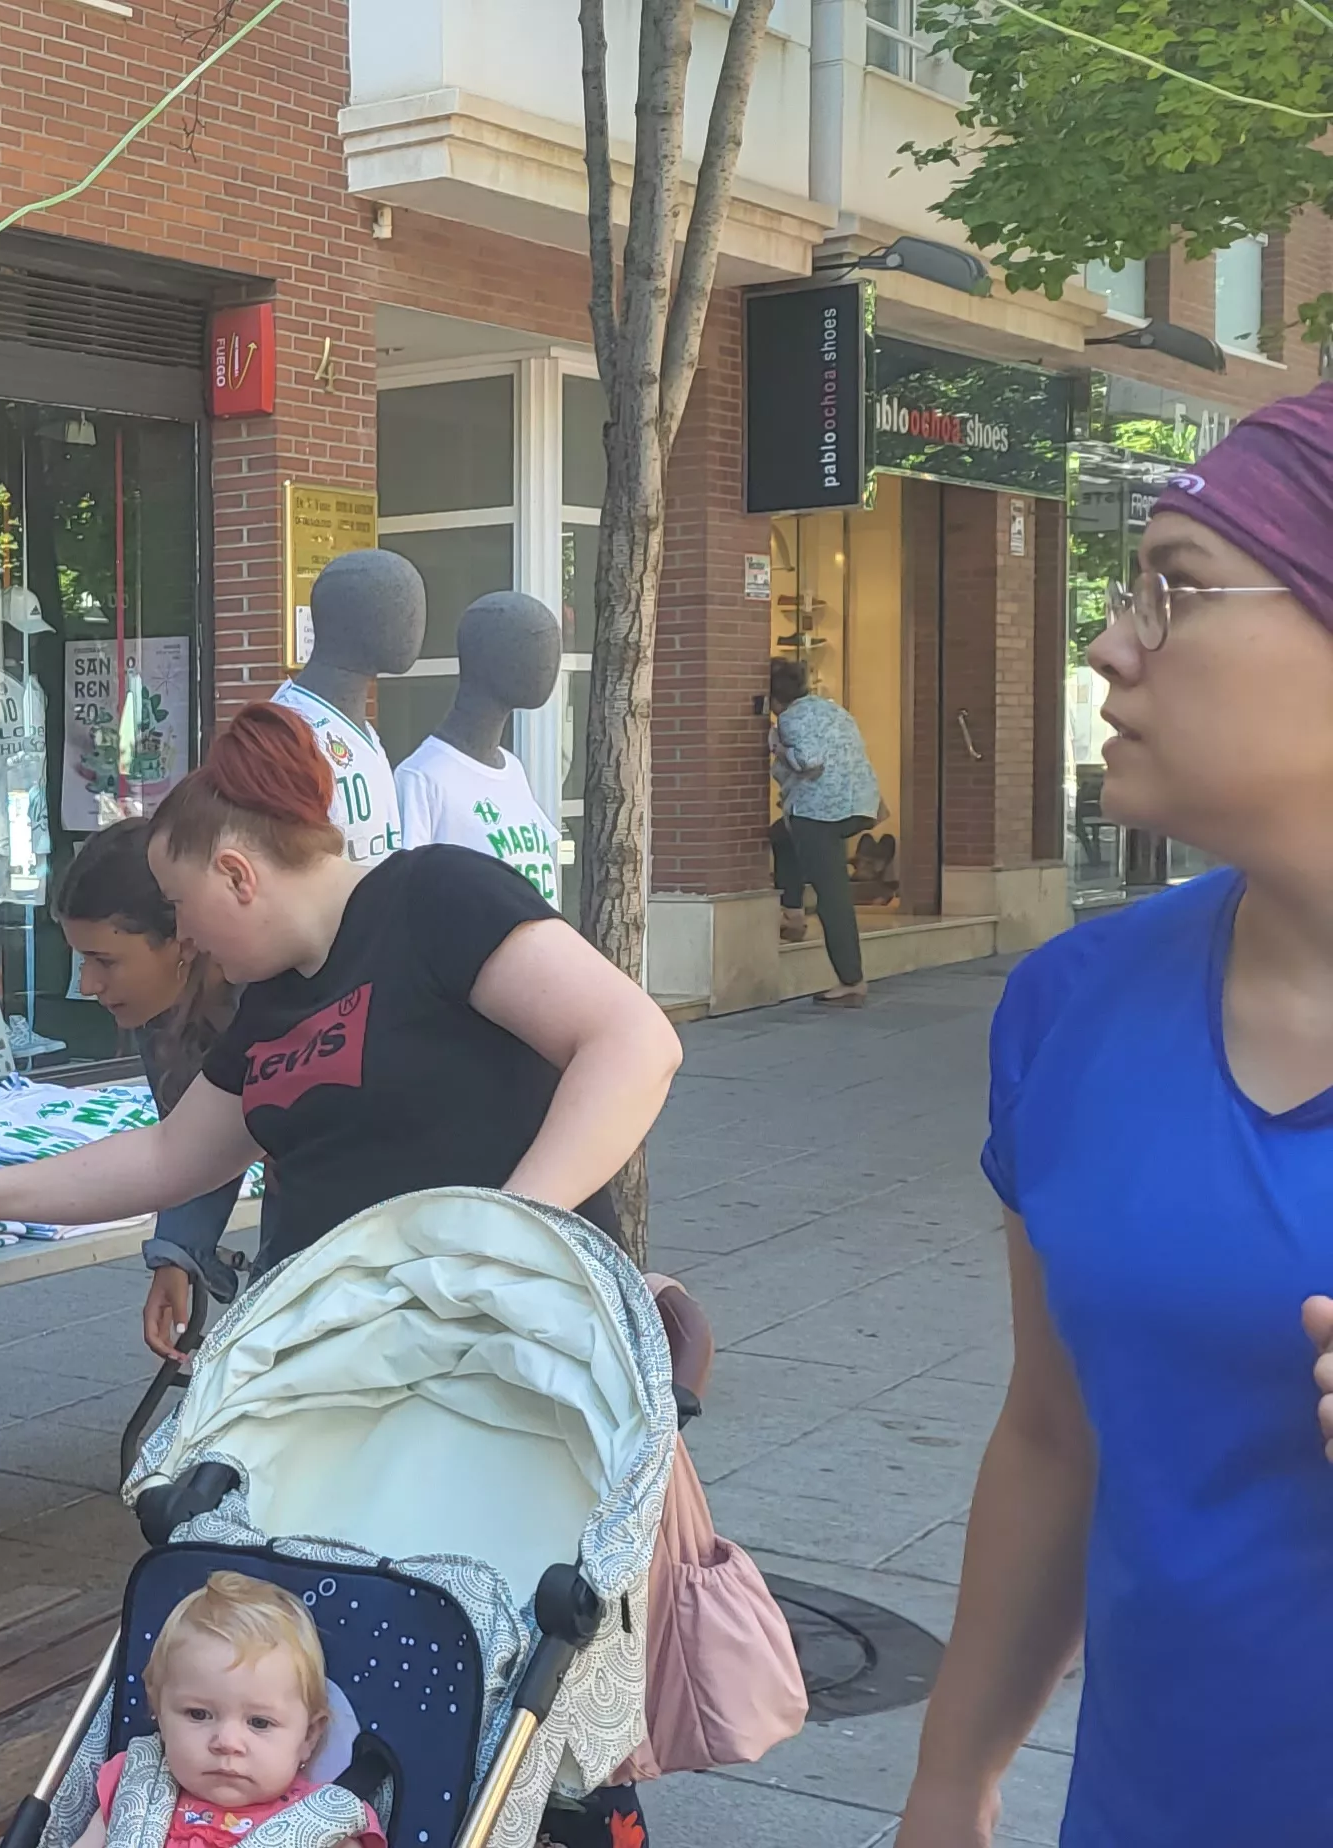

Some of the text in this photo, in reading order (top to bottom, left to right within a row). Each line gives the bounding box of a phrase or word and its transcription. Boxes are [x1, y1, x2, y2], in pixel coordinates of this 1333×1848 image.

[216, 337, 226, 388] FUEGO
[820, 307, 838, 489] pabloochoa.shoes
[74, 657, 111, 676] SAN
[74, 680, 110, 698] REN
[336, 772, 372, 825] 10
